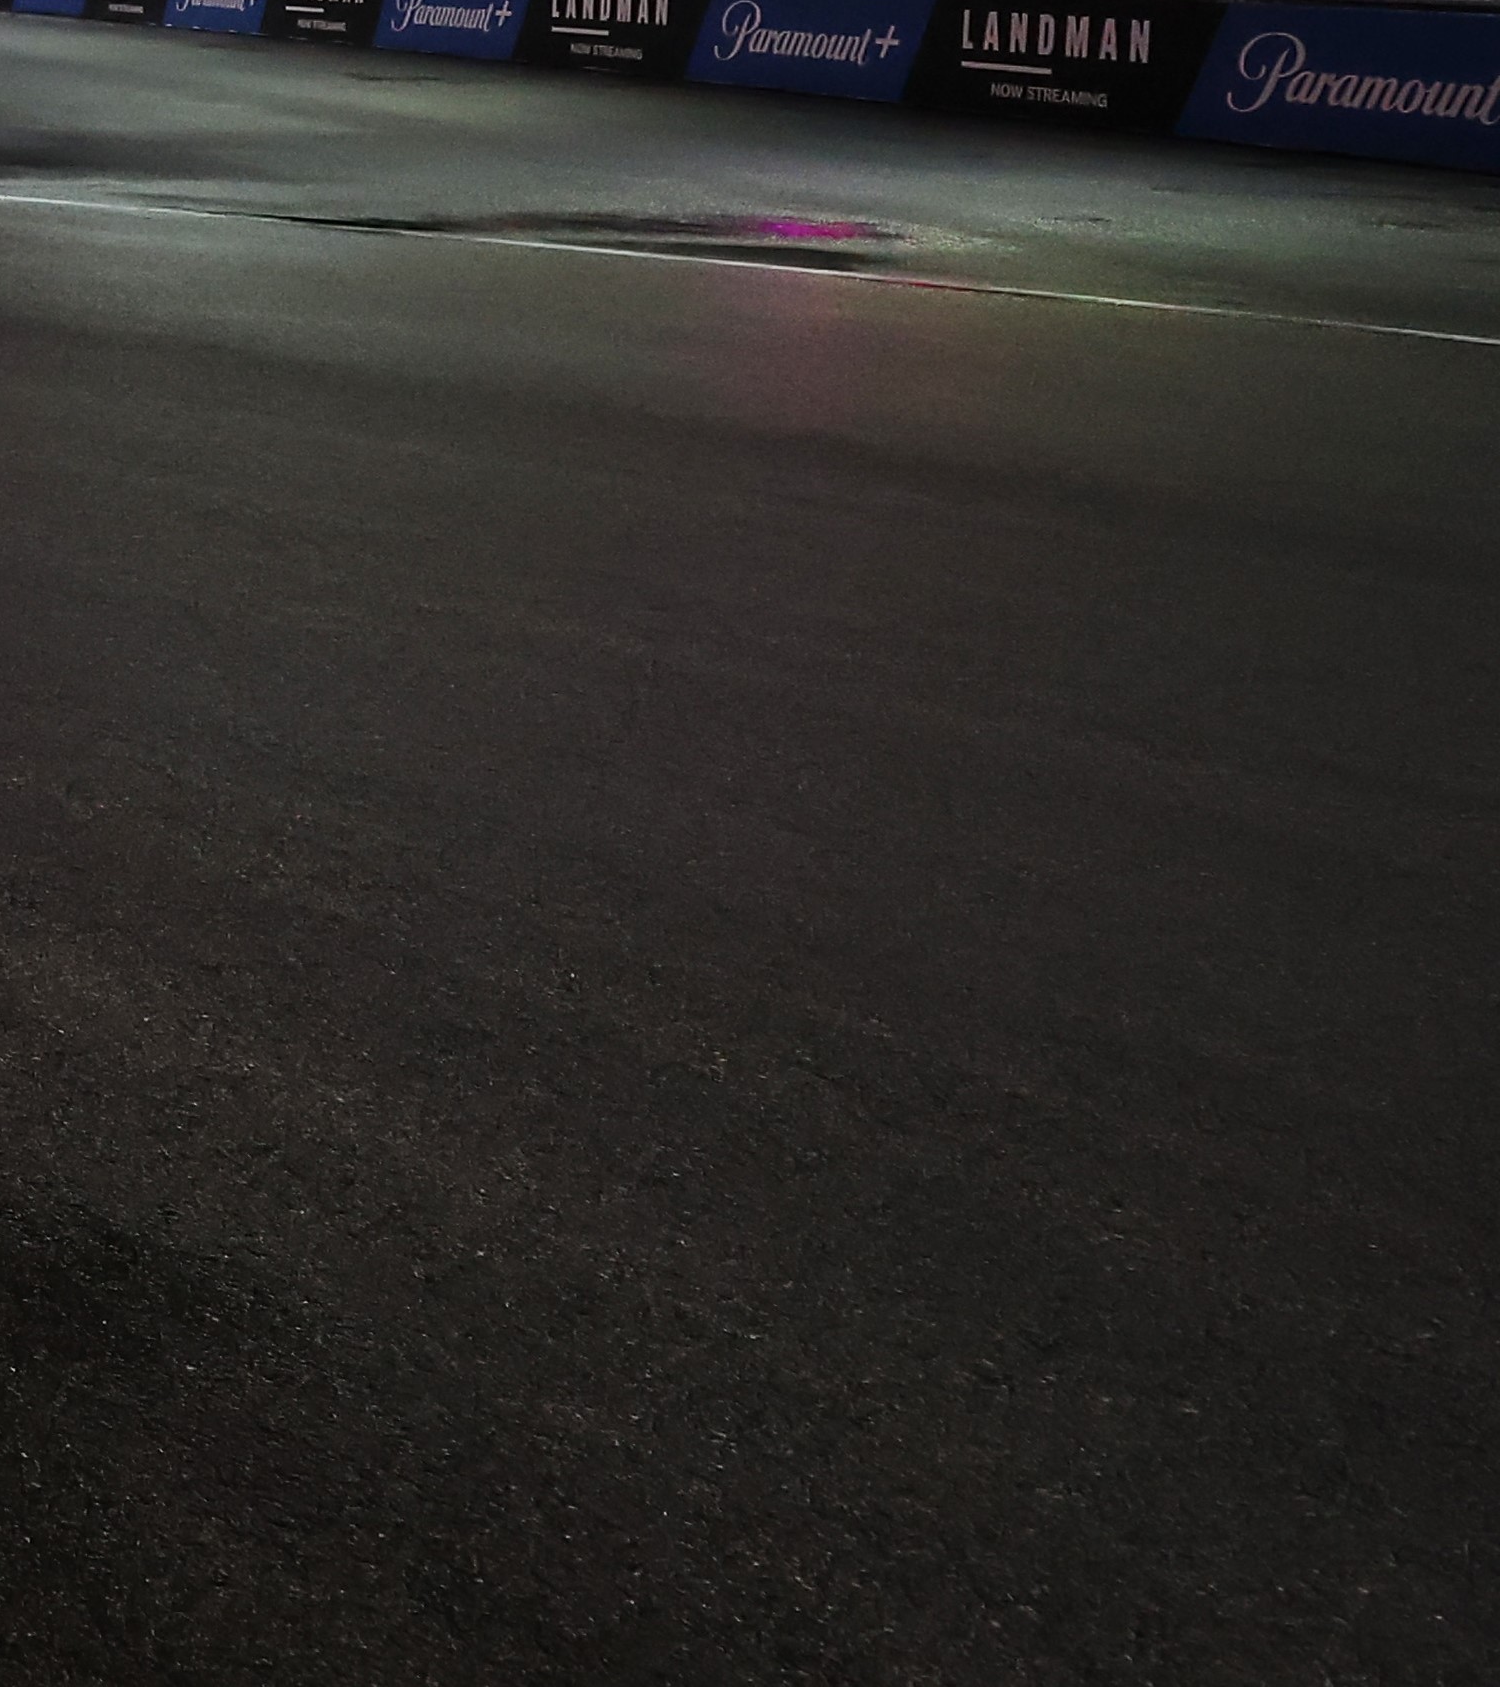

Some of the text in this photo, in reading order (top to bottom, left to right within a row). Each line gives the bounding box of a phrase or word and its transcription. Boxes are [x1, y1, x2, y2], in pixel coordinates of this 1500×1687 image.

[713, 0, 901, 66] Paramount+
[960, 9, 1151, 65] LANDMAN
[990, 82, 1108, 108] NOW STREAMING
